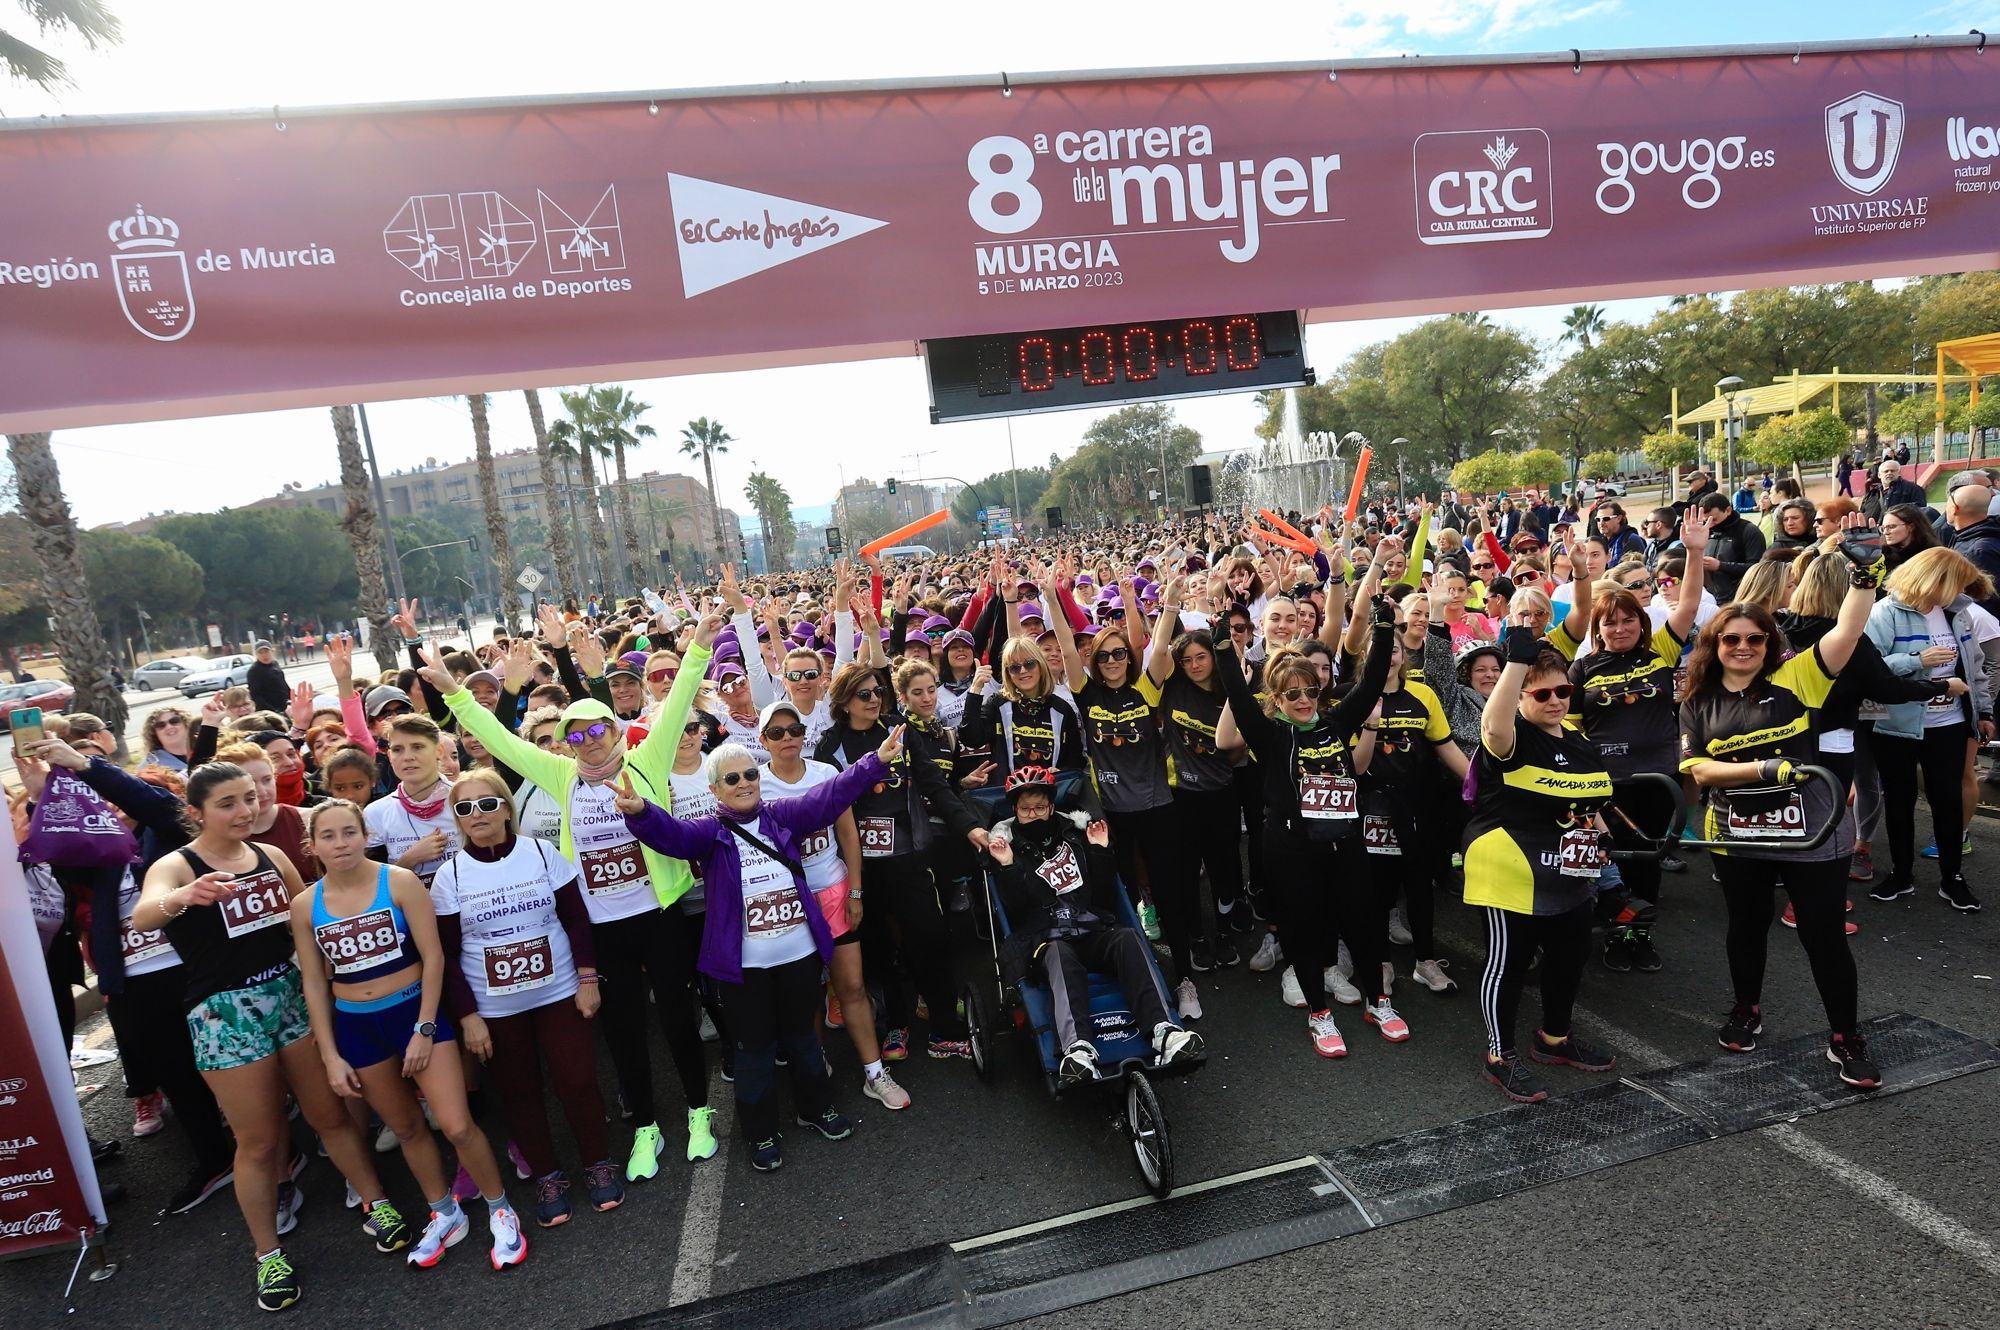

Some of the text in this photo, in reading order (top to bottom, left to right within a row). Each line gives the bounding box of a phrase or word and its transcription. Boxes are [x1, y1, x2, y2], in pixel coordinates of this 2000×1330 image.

[1055, 124, 1213, 163] carrera
[1946, 117, 2000, 161] lla
[1954, 164, 1991, 177] natural
[1428, 167, 1537, 217] CRC
[1955, 181, 1987, 192] frozen
[1109, 153, 1341, 263] mujer
[1810, 197, 1929, 223] UNIVERSAE
[680, 209, 840, 249] El Corte Inglés
[1431, 216, 1537, 232] CAJA RURAL CENTRAL
[1815, 218, 1926, 235] Instituto Superior de FP
[0, 243, 336, 288] Región de Murcia
[975, 239, 1120, 276] MURCIA
[400, 277, 632, 307] Concejalía de Deportes
[978, 271, 1124, 295] 5 DE MARZO 2023
[523, 573, 536, 584] 30
[1535, 777, 1585, 790] ZANCADAS
[1302, 789, 1353, 807] 4787
[83, 815, 120, 829] CRC
[591, 857, 637, 882] 296
[226, 885, 288, 919] 1611
[469, 889, 496, 901] CARRERA
[515, 880, 534, 889] MUJER
[471, 901, 490, 912] POR
[491, 893, 507, 906] MÍ
[517, 889, 538, 901] POR
[476, 896, 552, 923] COMPAÑERAS
[748, 900, 805, 927] 2482
[323, 926, 395, 959] 2888
[246, 961, 289, 985] NIKE
[494, 953, 545, 980] 928
[2, 1190, 29, 1201] fibra
